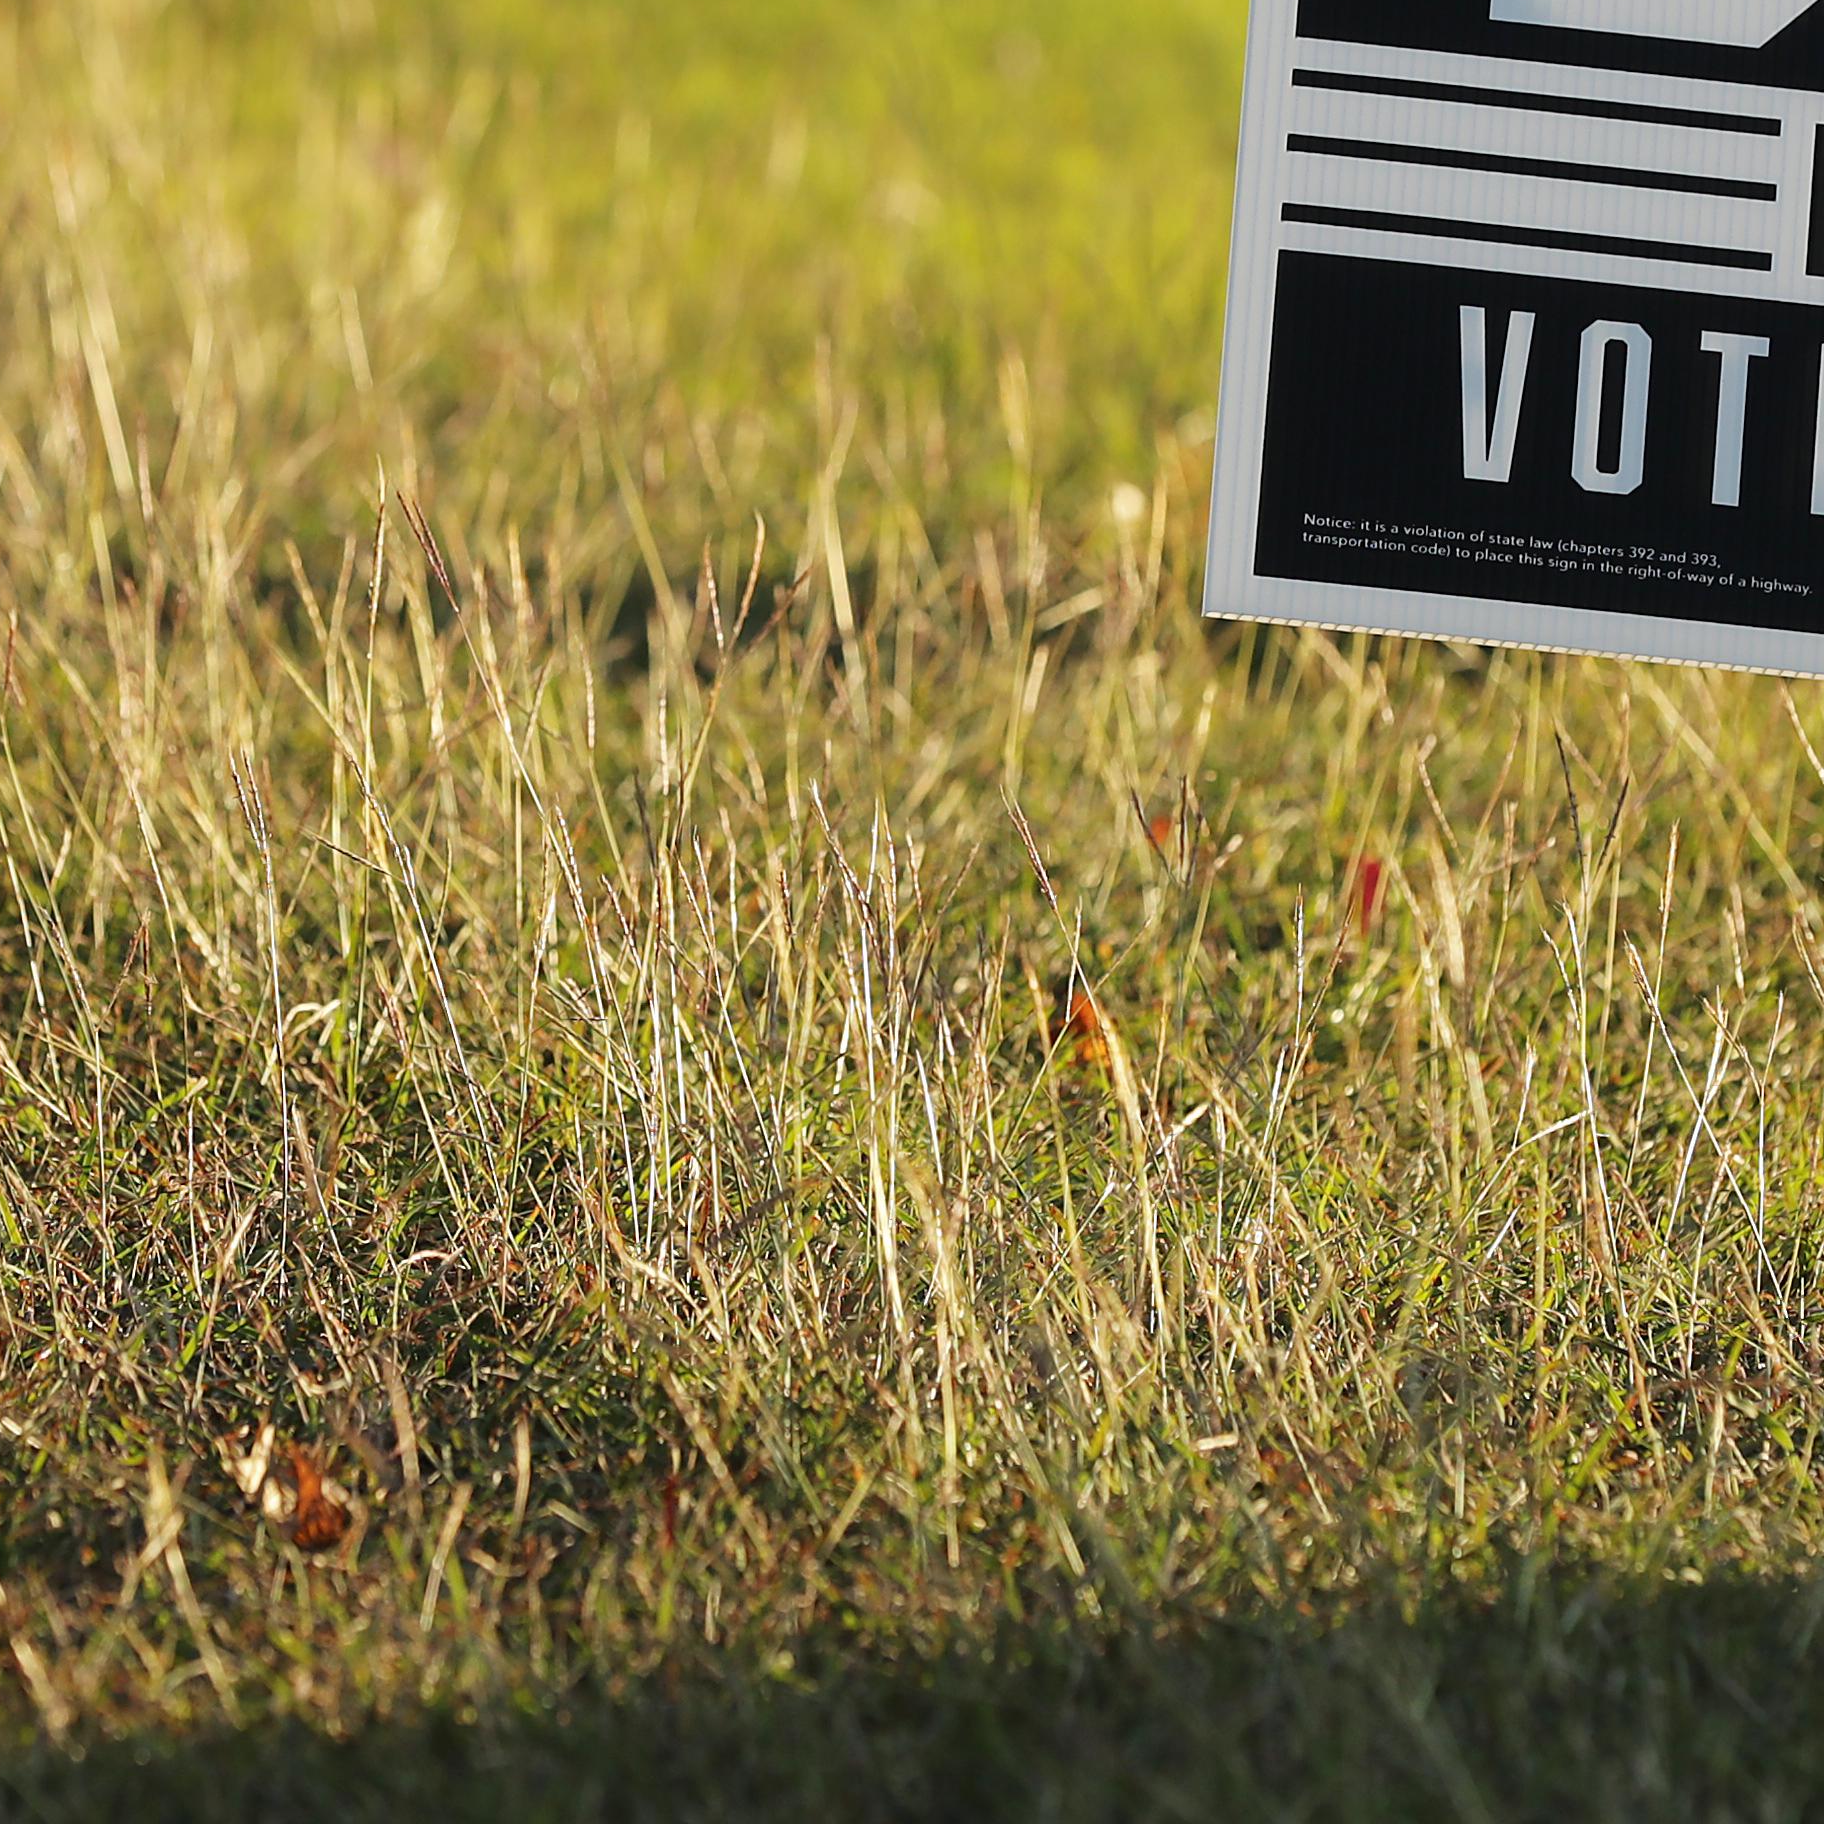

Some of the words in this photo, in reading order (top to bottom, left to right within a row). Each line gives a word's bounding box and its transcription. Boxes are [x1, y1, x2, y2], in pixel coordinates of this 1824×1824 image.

[1302, 531, 1406, 552] transportation
[1410, 543, 1451, 557] code)
[1456, 547, 1470, 558] to
[1475, 548, 1514, 563] place
[1518, 553, 1544, 566] this
[1548, 555, 1577, 572] sign
[1582, 559, 1595, 571] in
[1600, 561, 1624, 574] the
[1627, 564, 1715, 587] right-of-way
[1719, 573, 1735, 585] of
[1738, 578, 1746, 587] a
[1751, 576, 1813, 596] highway.
[1303, 512, 1356, 530] Notice:
[1360, 518, 1370, 531] it
[1375, 520, 1386, 532] is
[1390, 524, 1399, 534] a
[1403, 523, 1465, 541] violation
[1469, 530, 1485, 542] of
[1488, 533, 1525, 547] state
[1529, 536, 1553, 550] law
[1558, 539, 1624, 558] (chapters
[1628, 546, 1655, 560] 392
[1659, 551, 1687, 564] and
[1691, 553, 1721, 568] 393,
